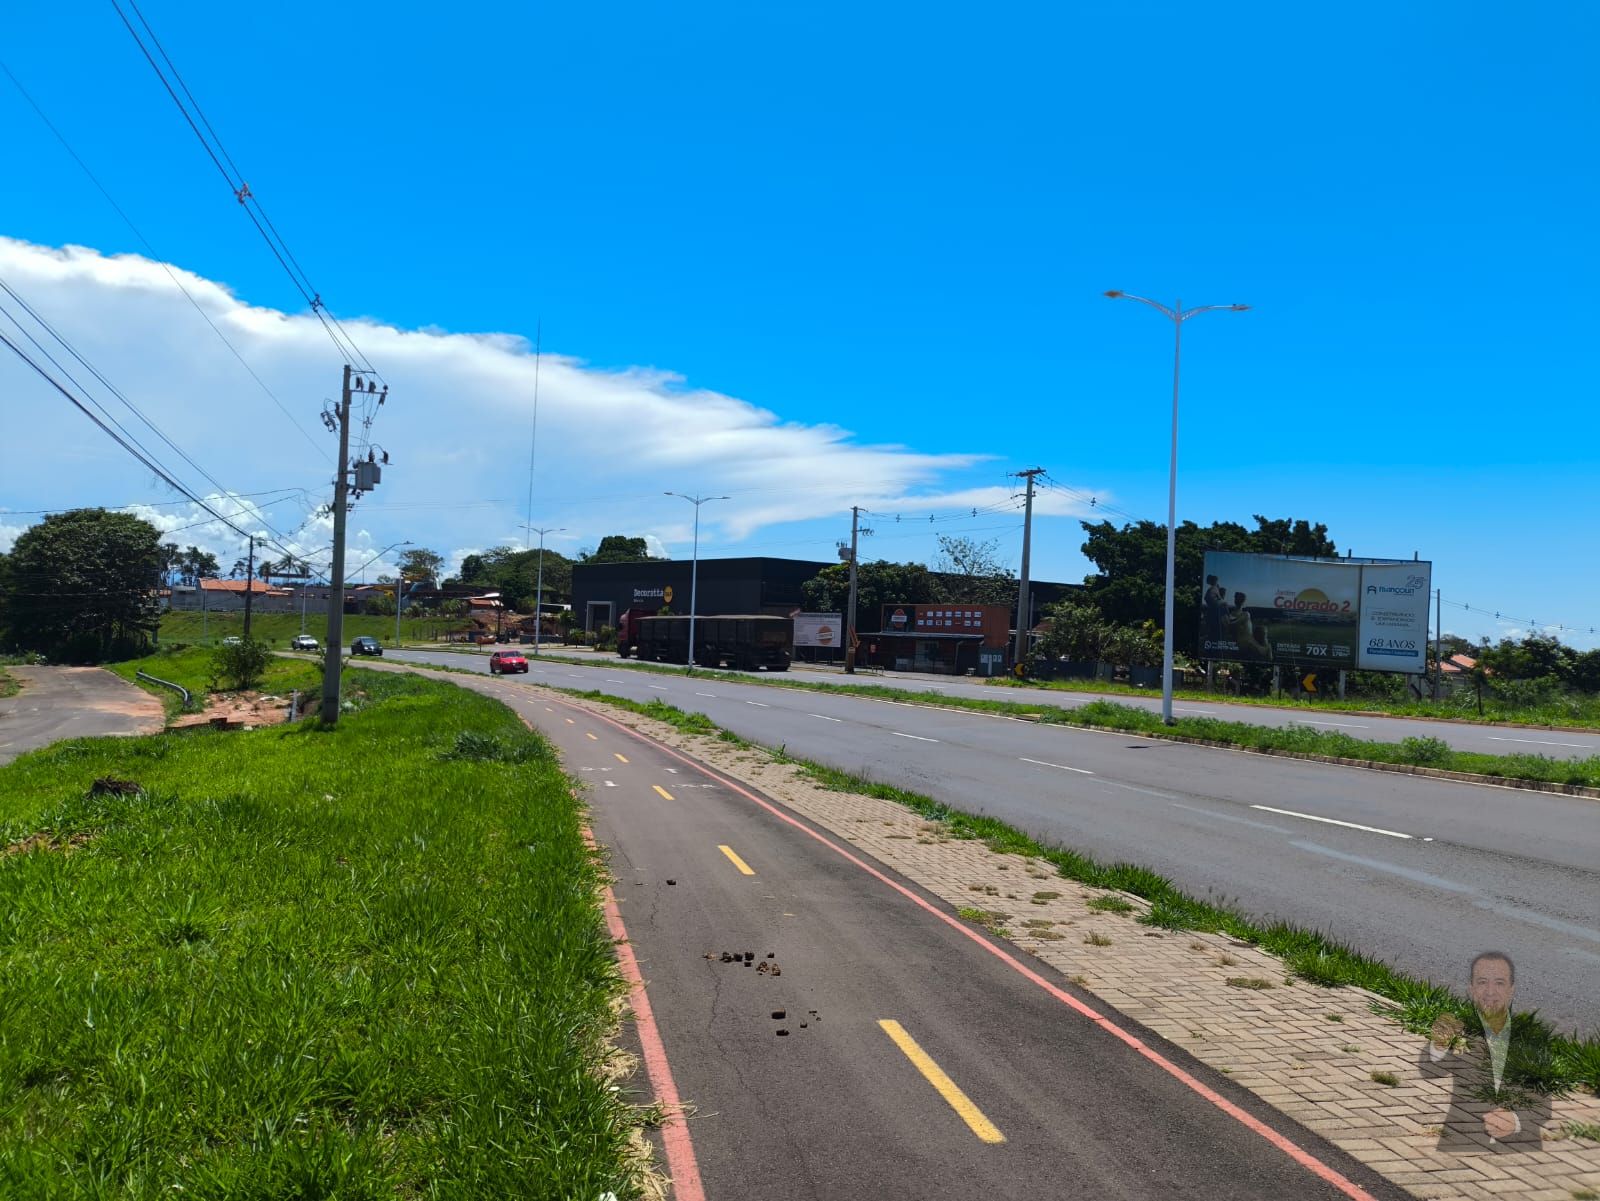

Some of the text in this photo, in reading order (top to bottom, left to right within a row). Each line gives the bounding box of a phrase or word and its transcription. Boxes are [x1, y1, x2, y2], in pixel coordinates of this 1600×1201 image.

[1274, 595, 1351, 613] Colorado 2
[1386, 639, 1416, 650] ANOS
[1306, 646, 1327, 656] 70X
